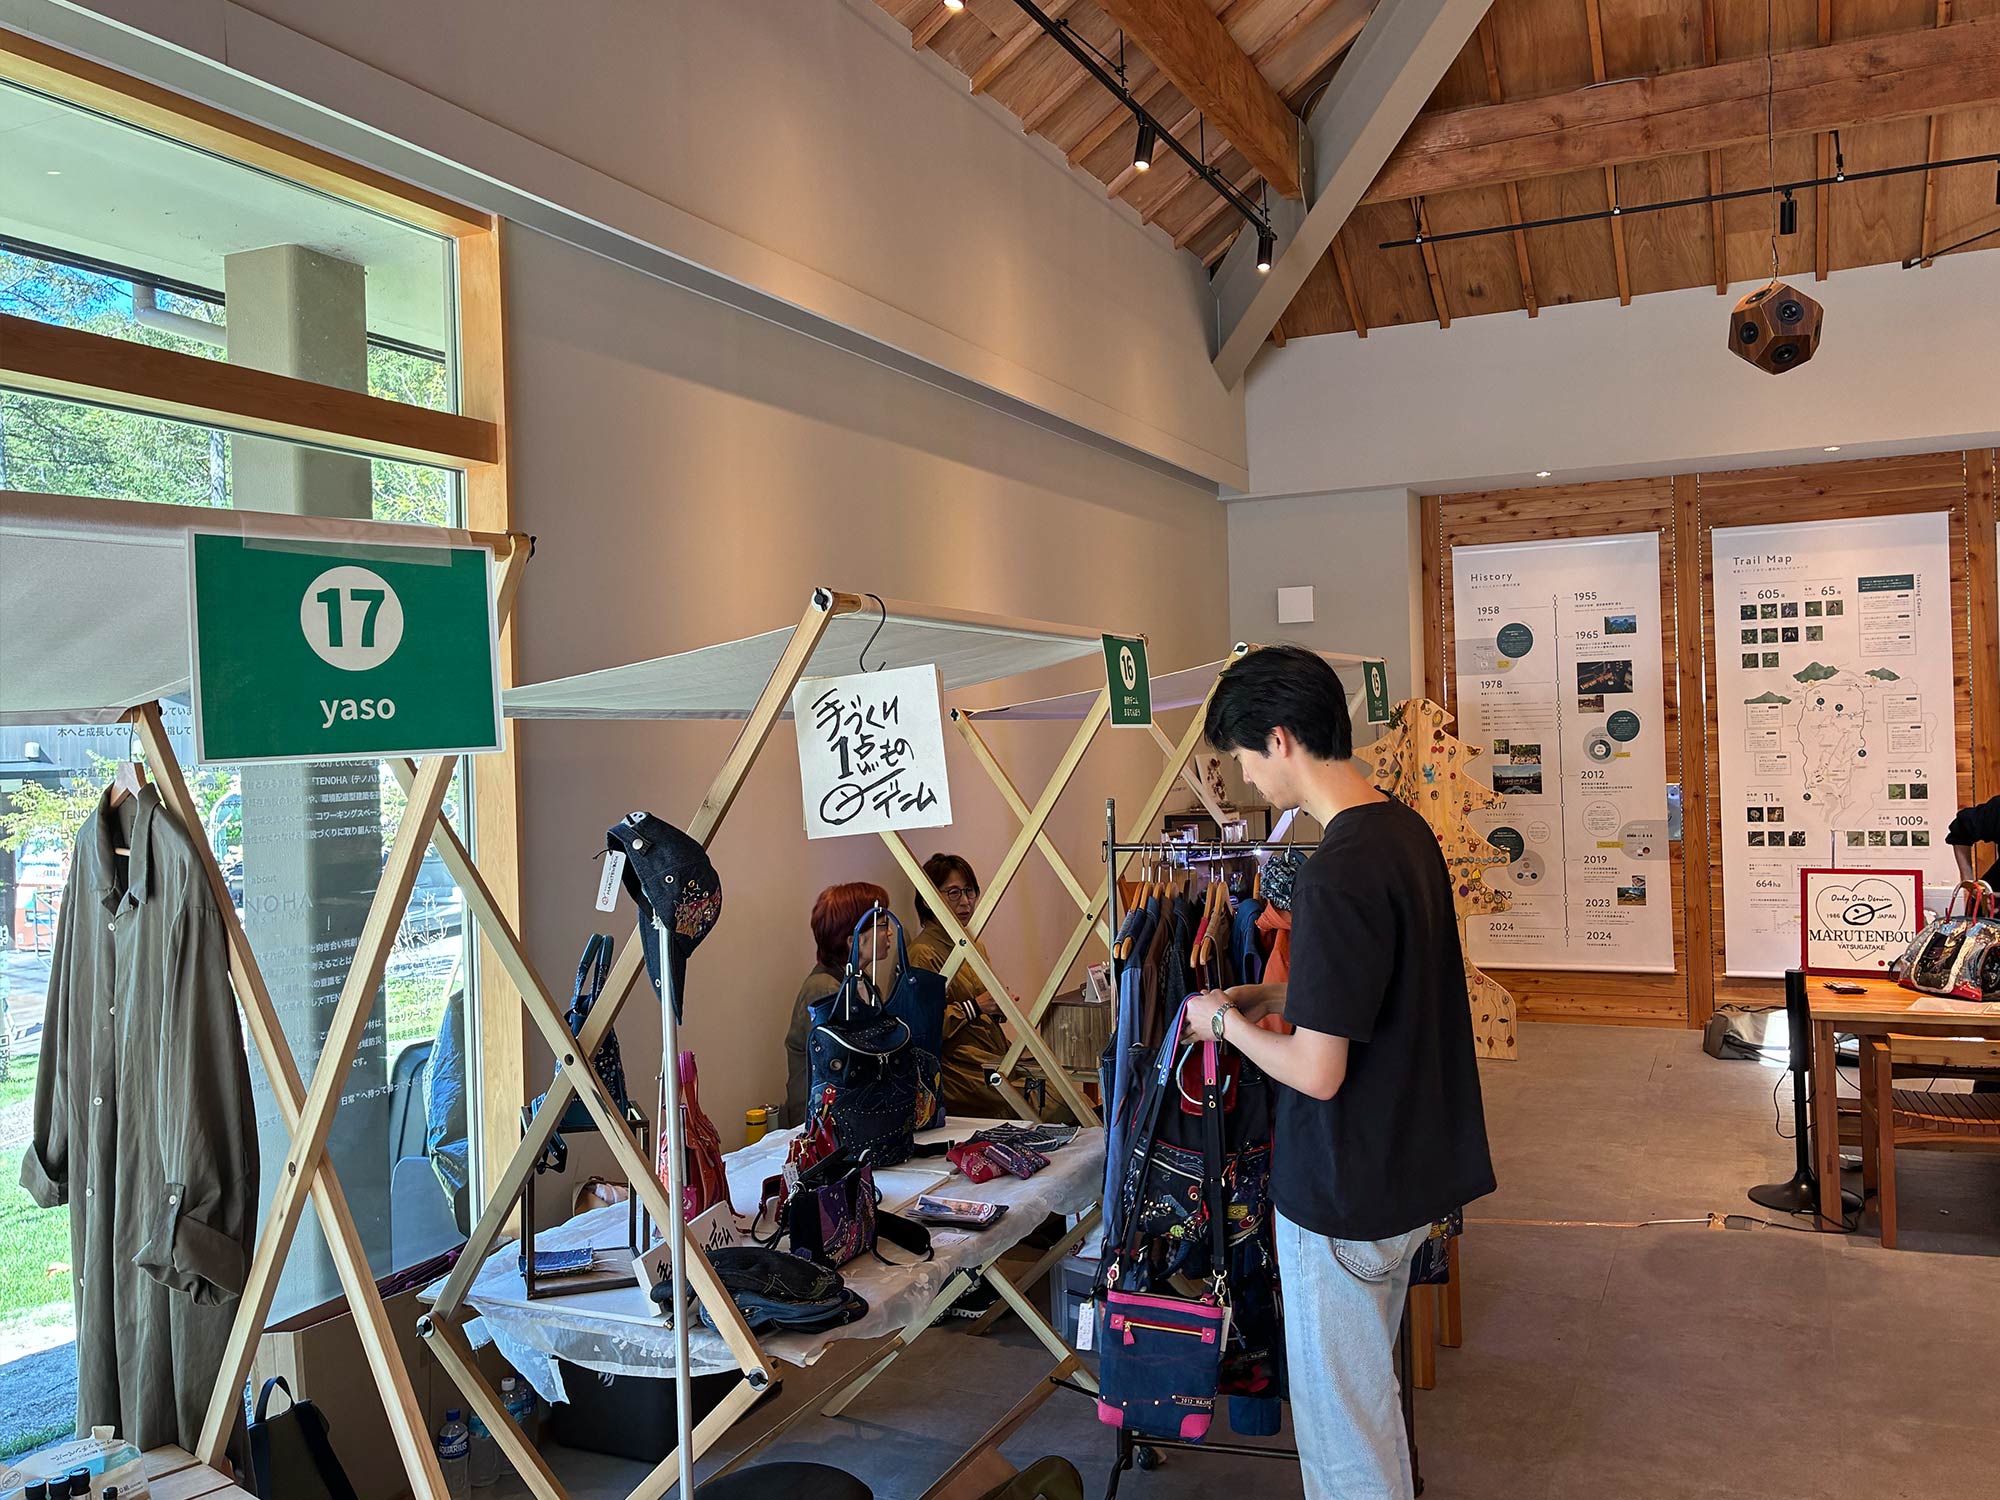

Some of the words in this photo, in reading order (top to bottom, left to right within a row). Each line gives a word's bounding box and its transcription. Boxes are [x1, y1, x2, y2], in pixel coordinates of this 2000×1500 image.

[1733, 556, 1760, 566] Trail
[1766, 555, 1792, 565] Map
[1470, 572, 1513, 584] History
[1757, 589, 1780, 599] 605
[1821, 586, 1836, 596] 65
[1574, 592, 1597, 601] 1955
[1477, 607, 1500, 615] 1958
[315, 588, 386, 649] 17
[1576, 631, 1599, 640] 1965
[1121, 655, 1134, 681] 16
[1480, 680, 1503, 689] 1978
[319, 696, 396, 729] yaso
[811, 687, 899, 742] 手づくり
[1581, 770, 1605, 779] 2012
[1914, 769, 1922, 779] 9
[1764, 793, 1774, 802] 11
[1895, 816, 1923, 826] 1009
[1583, 855, 1608, 864] 2019
[1585, 899, 1611, 908] 2023
[1831, 894, 1850, 904] Only
[1851, 894, 1866, 902] One
[1867, 894, 1892, 902] Denim
[1489, 922, 1514, 931] 2024
[1586, 931, 1612, 940] 2024
[1808, 929, 1915, 944] MARUTENBOU
[1837, 943, 1887, 951] YATSUGATAKE
